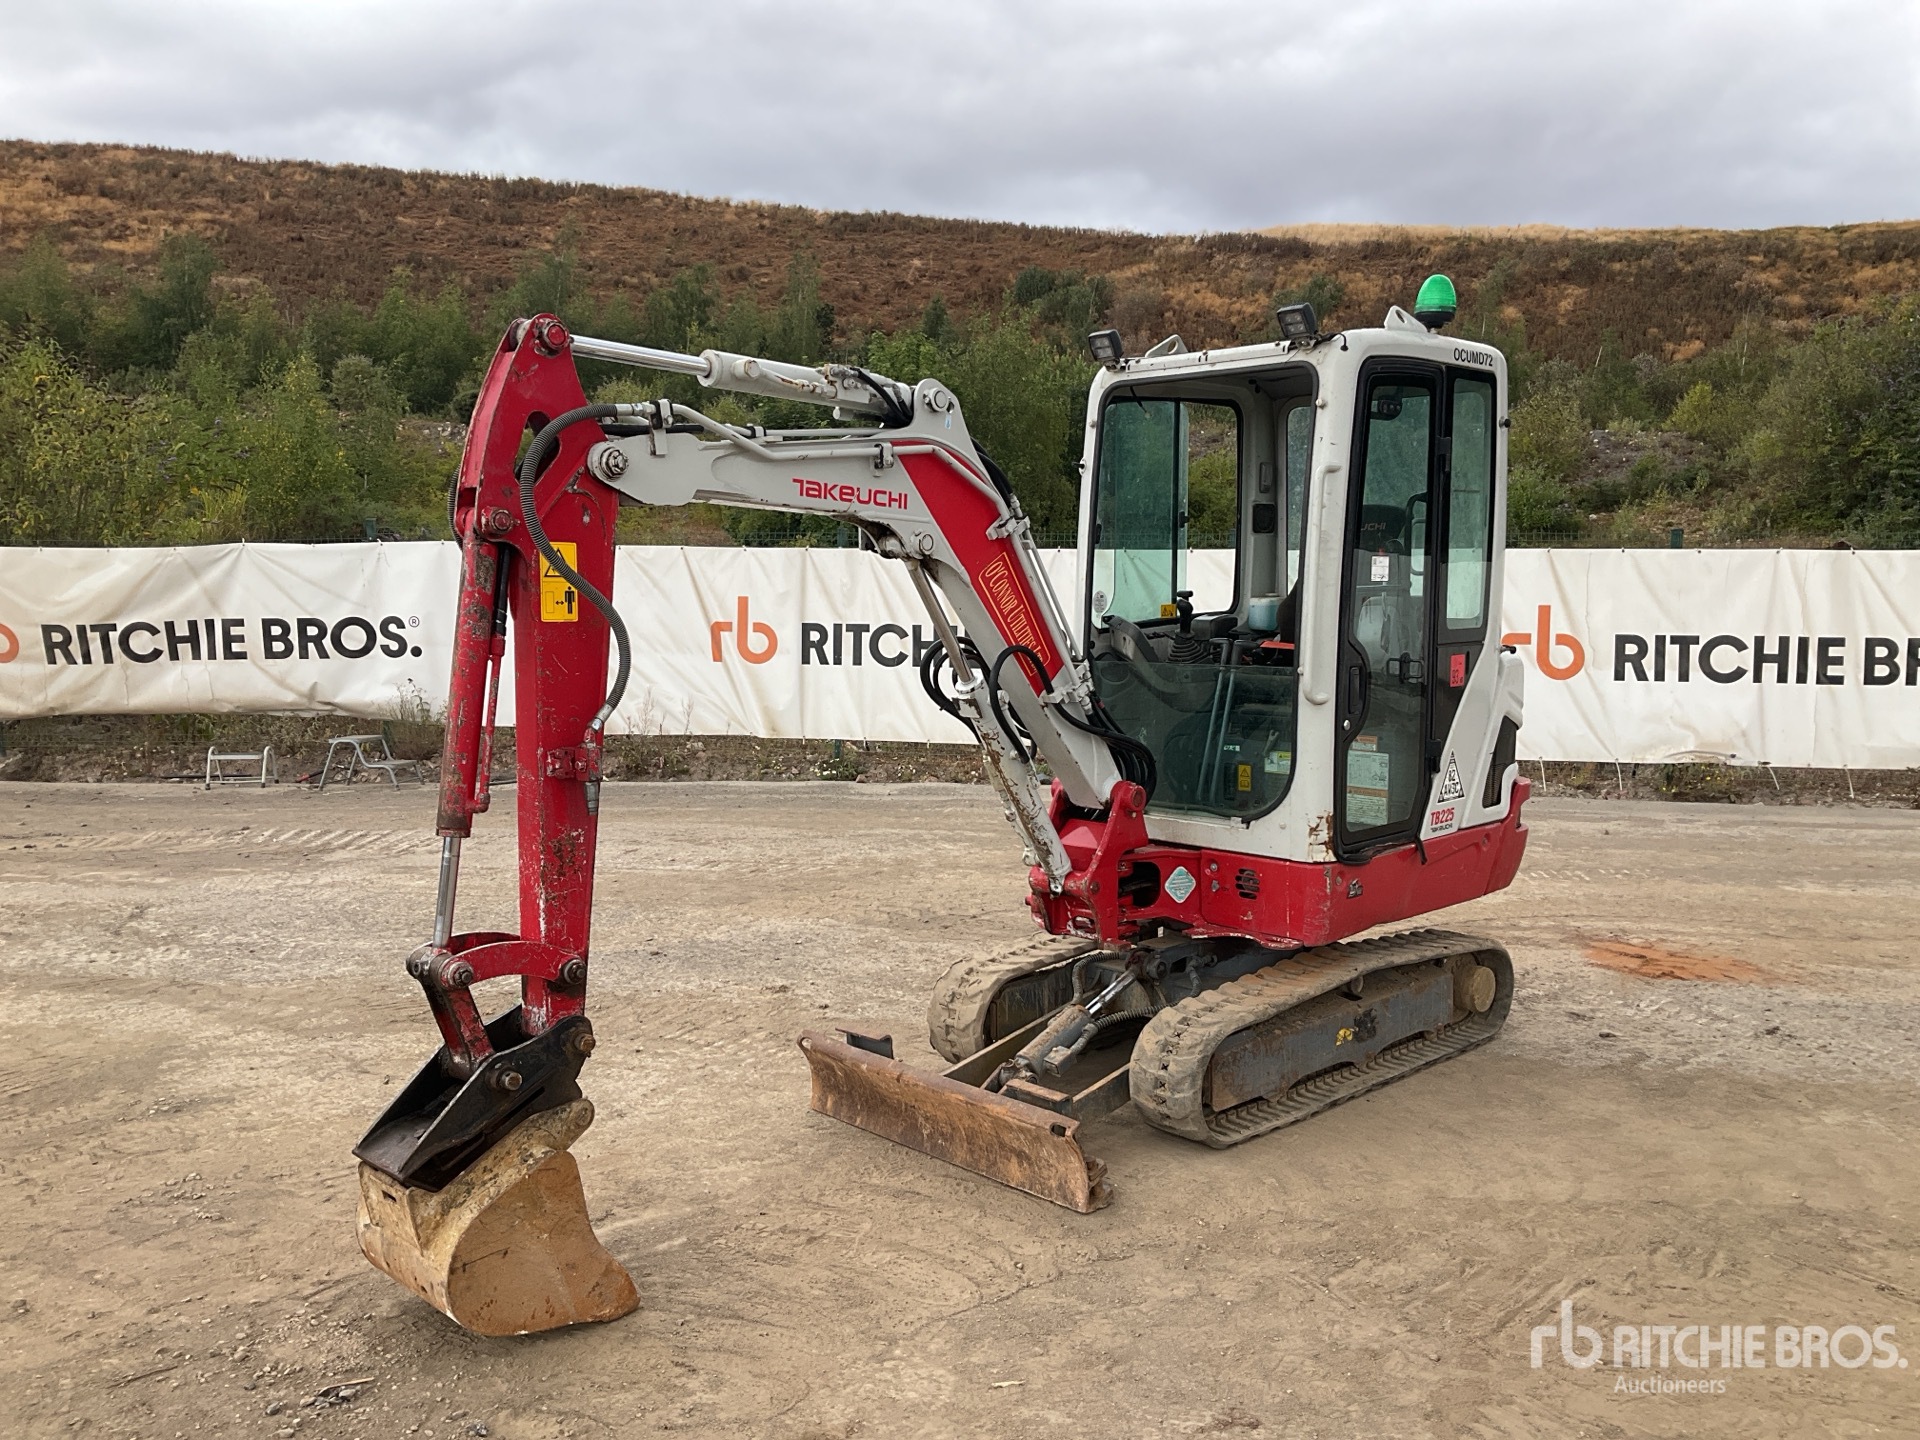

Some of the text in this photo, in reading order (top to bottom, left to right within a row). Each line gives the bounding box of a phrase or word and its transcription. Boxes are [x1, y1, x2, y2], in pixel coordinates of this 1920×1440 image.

[41, 618, 248, 665] RITCHIE
[261, 615, 423, 660] BROS.
[710, 596, 778, 665] rb
[1613, 633, 1846, 686] RITCHIE
[1430, 807, 1455, 827] TB225
